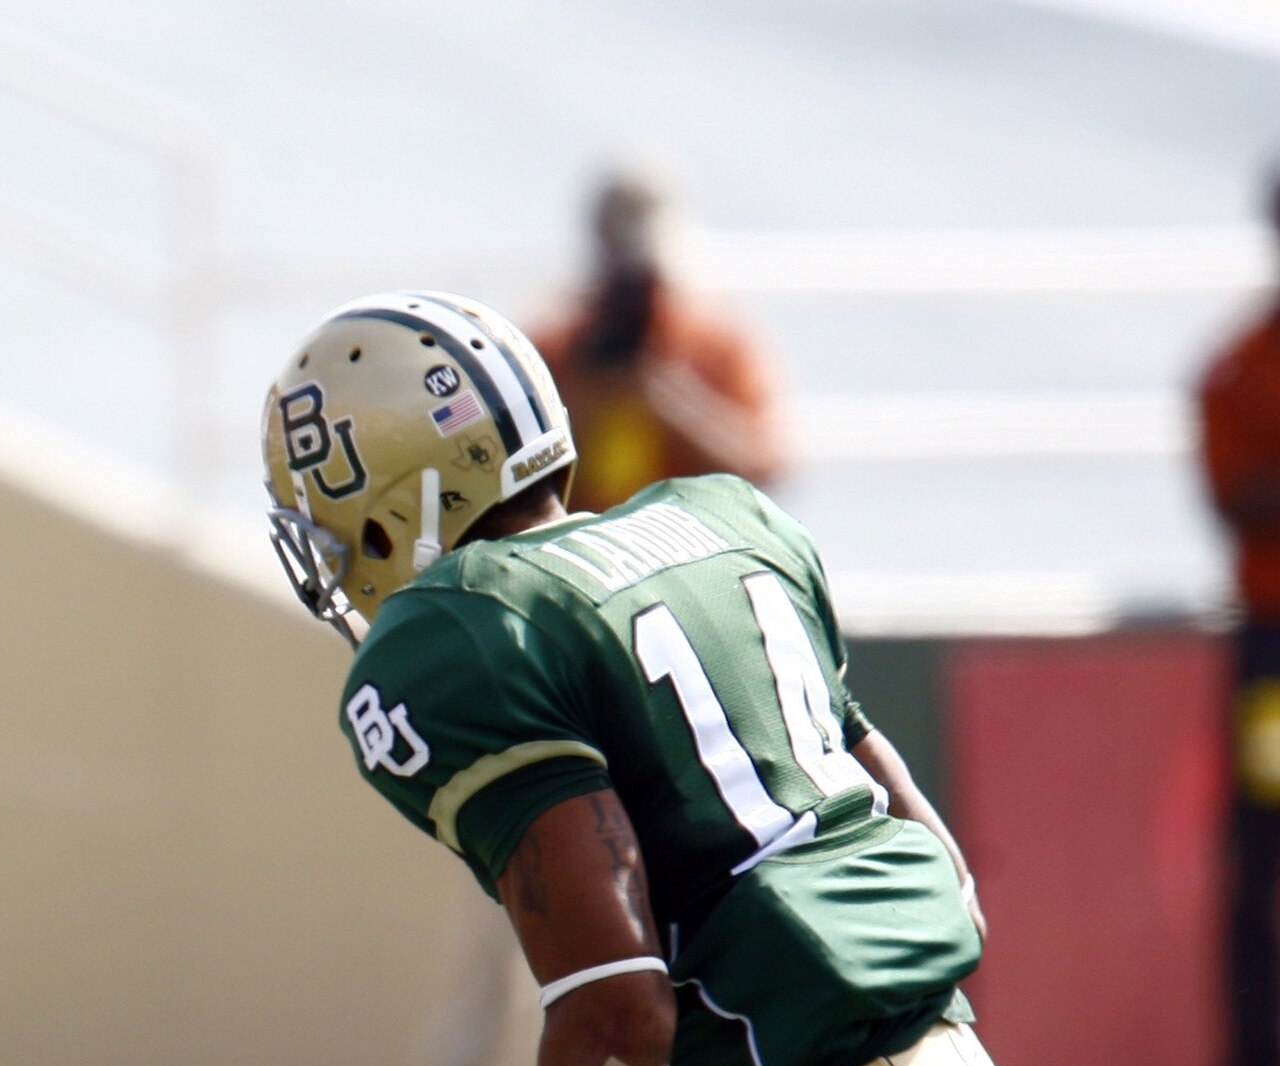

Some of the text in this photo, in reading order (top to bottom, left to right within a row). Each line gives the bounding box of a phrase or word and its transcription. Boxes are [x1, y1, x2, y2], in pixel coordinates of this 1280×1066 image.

[426, 366, 458, 396] KW
[279, 380, 368, 500] BU
[345, 683, 431, 778] BU
[632, 568, 890, 876] 14
